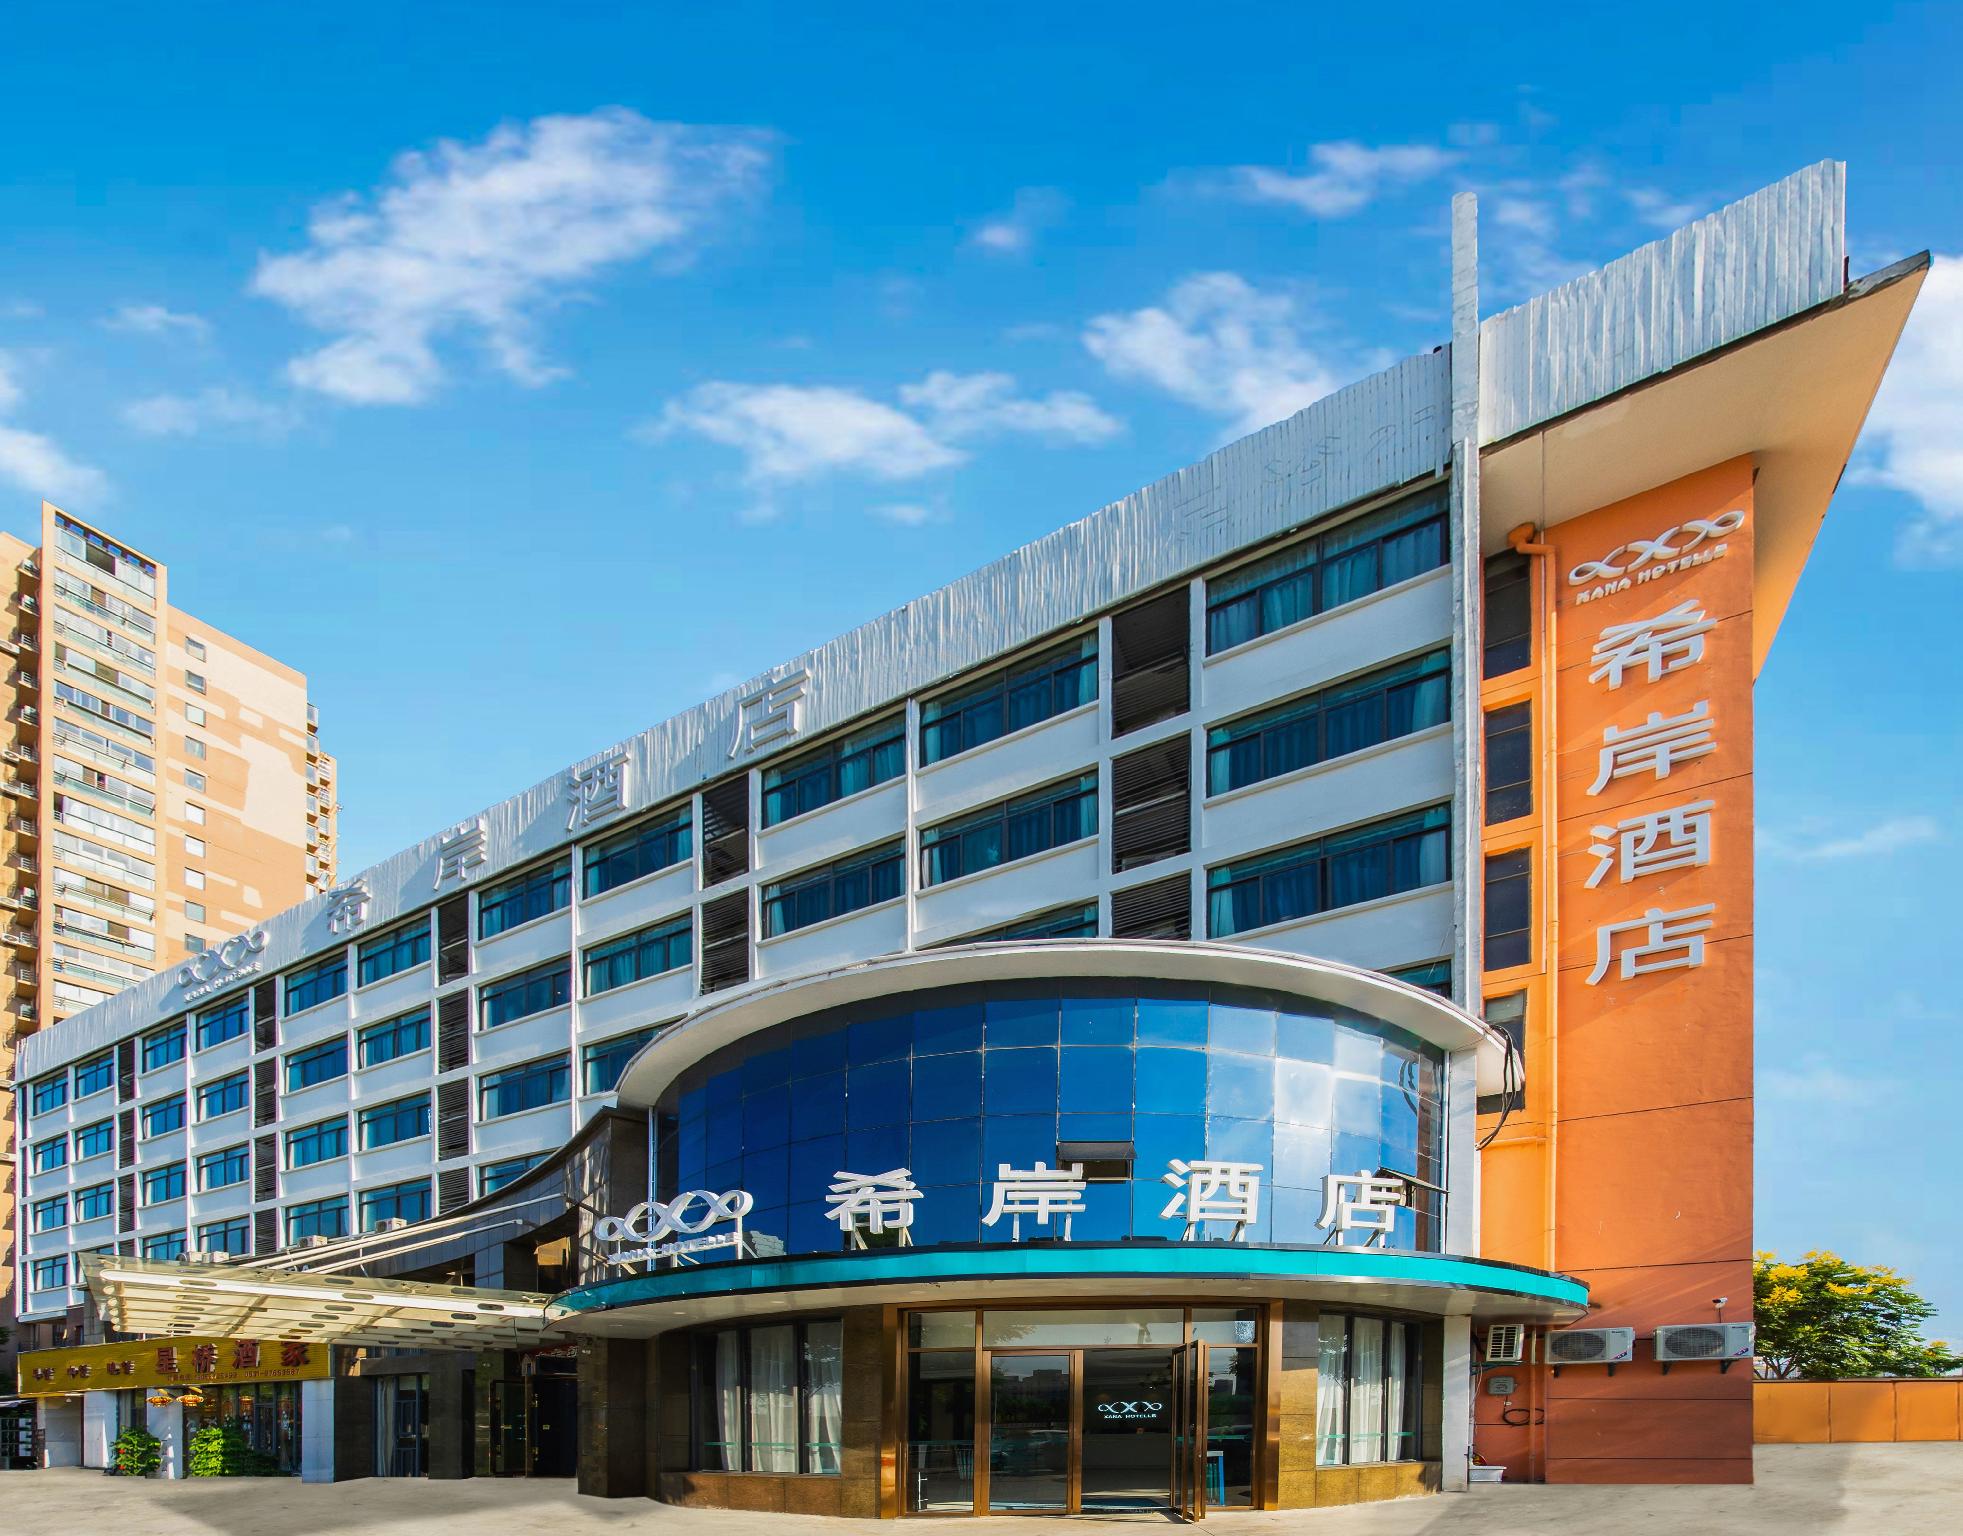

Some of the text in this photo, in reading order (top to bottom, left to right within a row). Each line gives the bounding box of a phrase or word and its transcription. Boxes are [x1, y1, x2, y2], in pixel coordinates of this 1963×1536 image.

[1637, 543, 1728, 585] HOTELLE
[325, 667, 811, 935] 希岸酒店
[1584, 599, 1718, 986] 希岸酒店
[825, 1160, 1404, 1234] 希岸酒店
